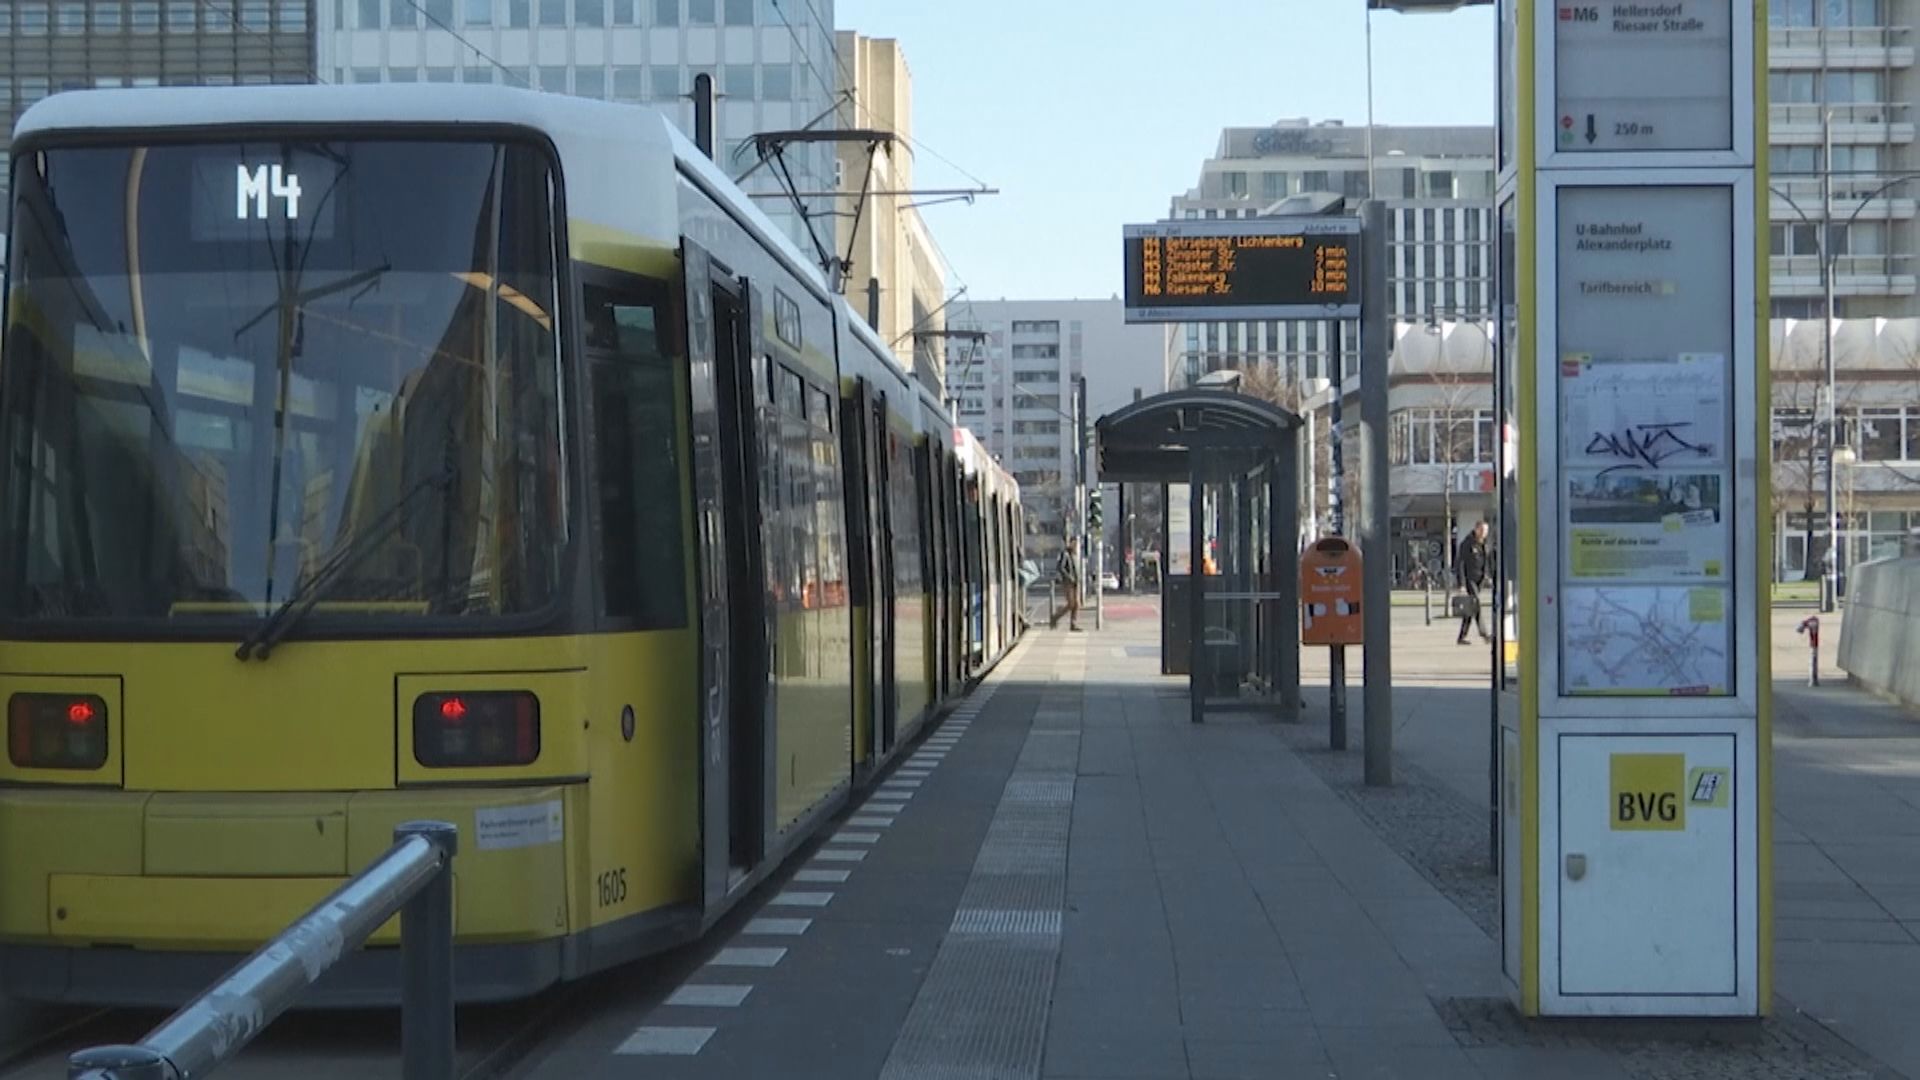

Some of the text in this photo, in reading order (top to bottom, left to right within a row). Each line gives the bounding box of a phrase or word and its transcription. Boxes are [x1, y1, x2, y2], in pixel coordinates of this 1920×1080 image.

[1573, 4, 1683, 21] M6 Hellersdorf
[1612, 19, 1704, 32] Riesaer Straße
[1614, 123, 1653, 136] 250 m
[237, 164, 302, 219] M4
[1576, 223, 1644, 236] U-Bahnhof
[1237, 236, 1304, 248] Lichtenberg
[1576, 238, 1672, 252] Alexanderplatz
[1326, 246, 1347, 257] min
[1326, 258, 1347, 268] min
[1326, 270, 1347, 280] min
[1326, 281, 1347, 292] min
[1580, 281, 1652, 294] Tarifbereich
[1618, 792, 1677, 822] BVG
[597, 867, 627, 908] 1605
